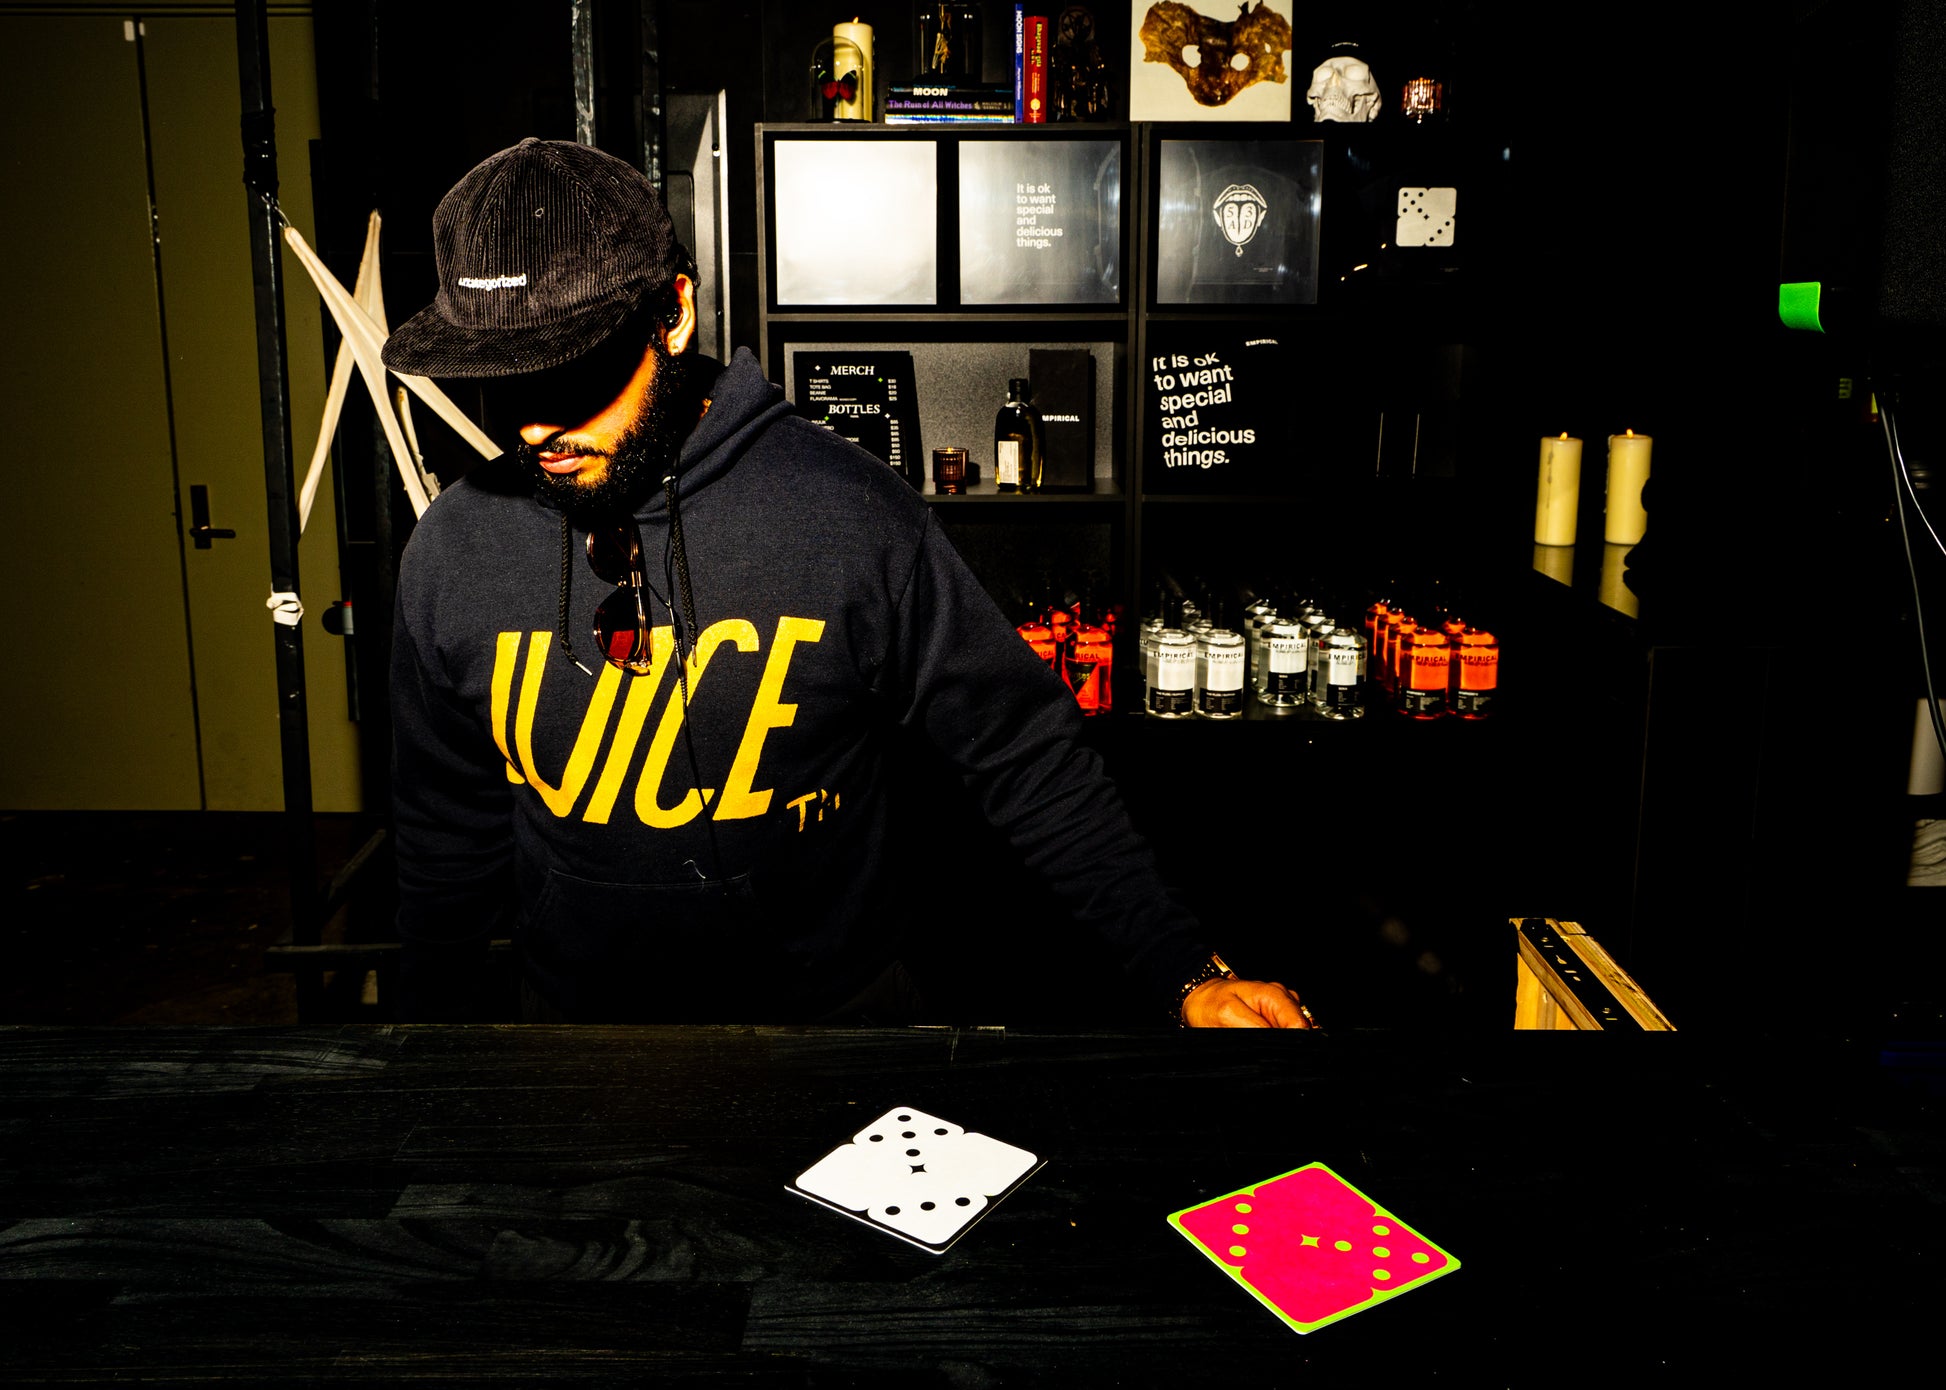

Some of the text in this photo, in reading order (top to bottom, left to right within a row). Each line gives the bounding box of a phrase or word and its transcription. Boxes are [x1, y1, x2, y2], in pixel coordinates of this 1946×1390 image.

[913, 88, 948, 96] MOON
[888, 100, 972, 110] The Ruin of All Witches
[1017, 183, 1051, 194] It is ok
[1016, 194, 1057, 204] to want
[1016, 204, 1054, 217] special
[1016, 215, 1037, 226] and
[1016, 226, 1063, 237] delicious
[1016, 237, 1052, 249] things.
[830, 365, 875, 376] MERCH
[1154, 364, 1234, 391] to want
[1160, 382, 1232, 414] special
[828, 404, 881, 415] BOTTLES
[1161, 410, 1199, 429] and
[1161, 427, 1256, 447] delicious
[1163, 447, 1230, 469] things.
[1204, 650, 1242, 660] EMPIRICA
[1410, 654, 1449, 663] MPIRICAL
[491, 615, 826, 830] JUICE
